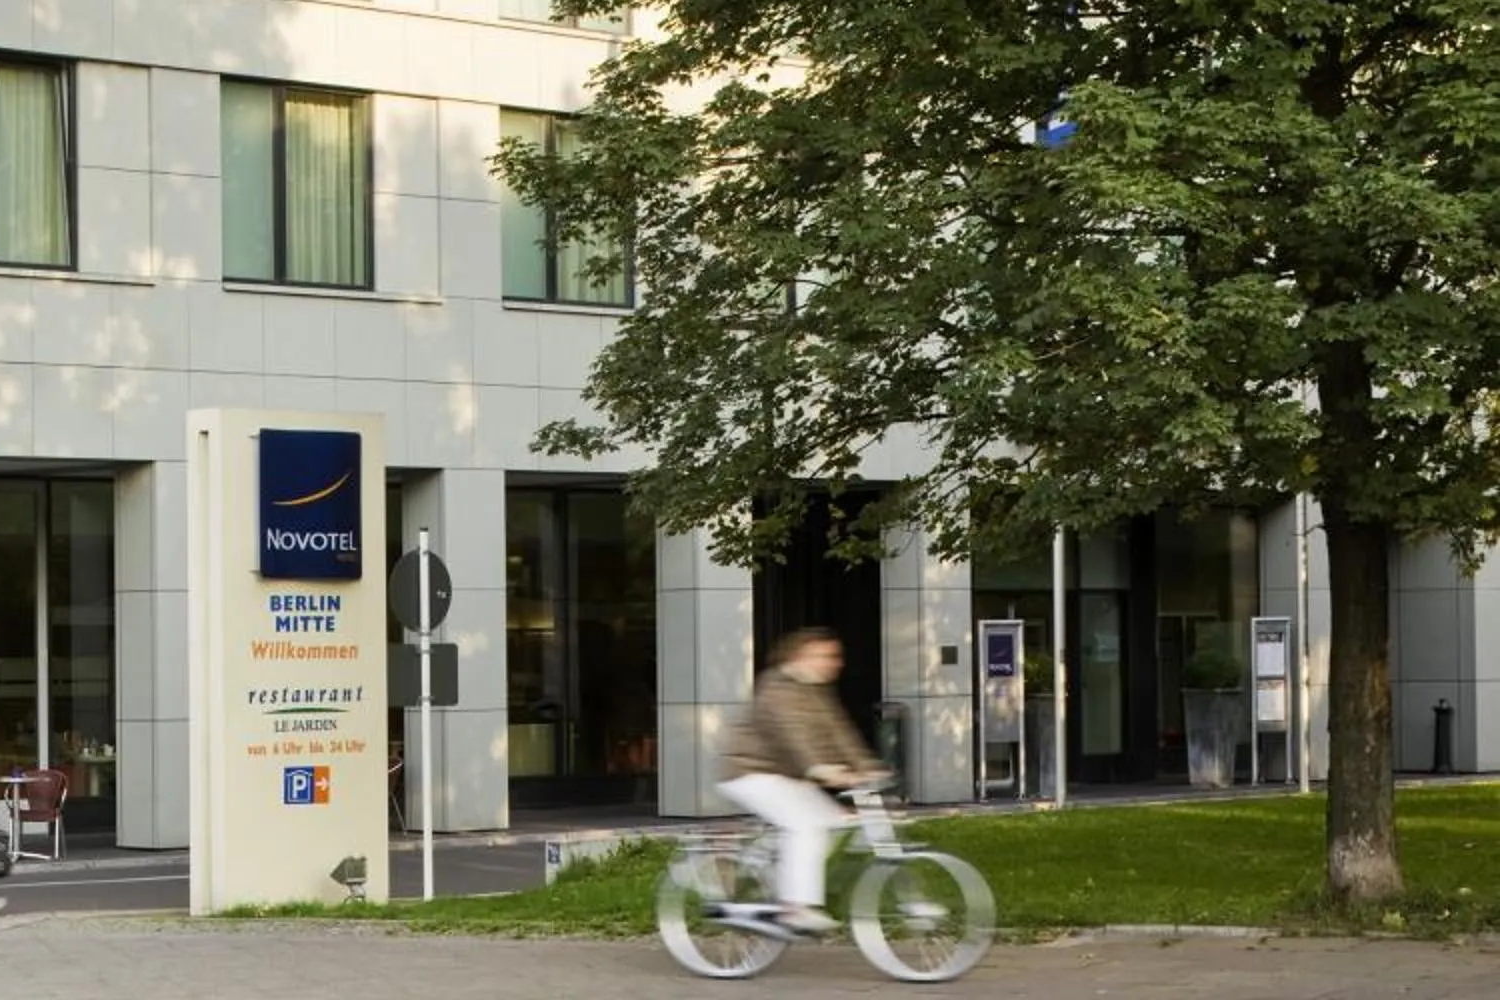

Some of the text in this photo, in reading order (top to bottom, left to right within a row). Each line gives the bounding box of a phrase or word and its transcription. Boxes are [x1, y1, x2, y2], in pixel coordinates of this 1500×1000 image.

[266, 528, 357, 551] NOVOTEL
[269, 595, 341, 612] BERLIN
[275, 616, 336, 632] MITTE
[252, 641, 359, 659] Willkommen
[248, 686, 364, 704] restaurant
[274, 719, 338, 732] LE JARDIN
[291, 774, 307, 799] P
